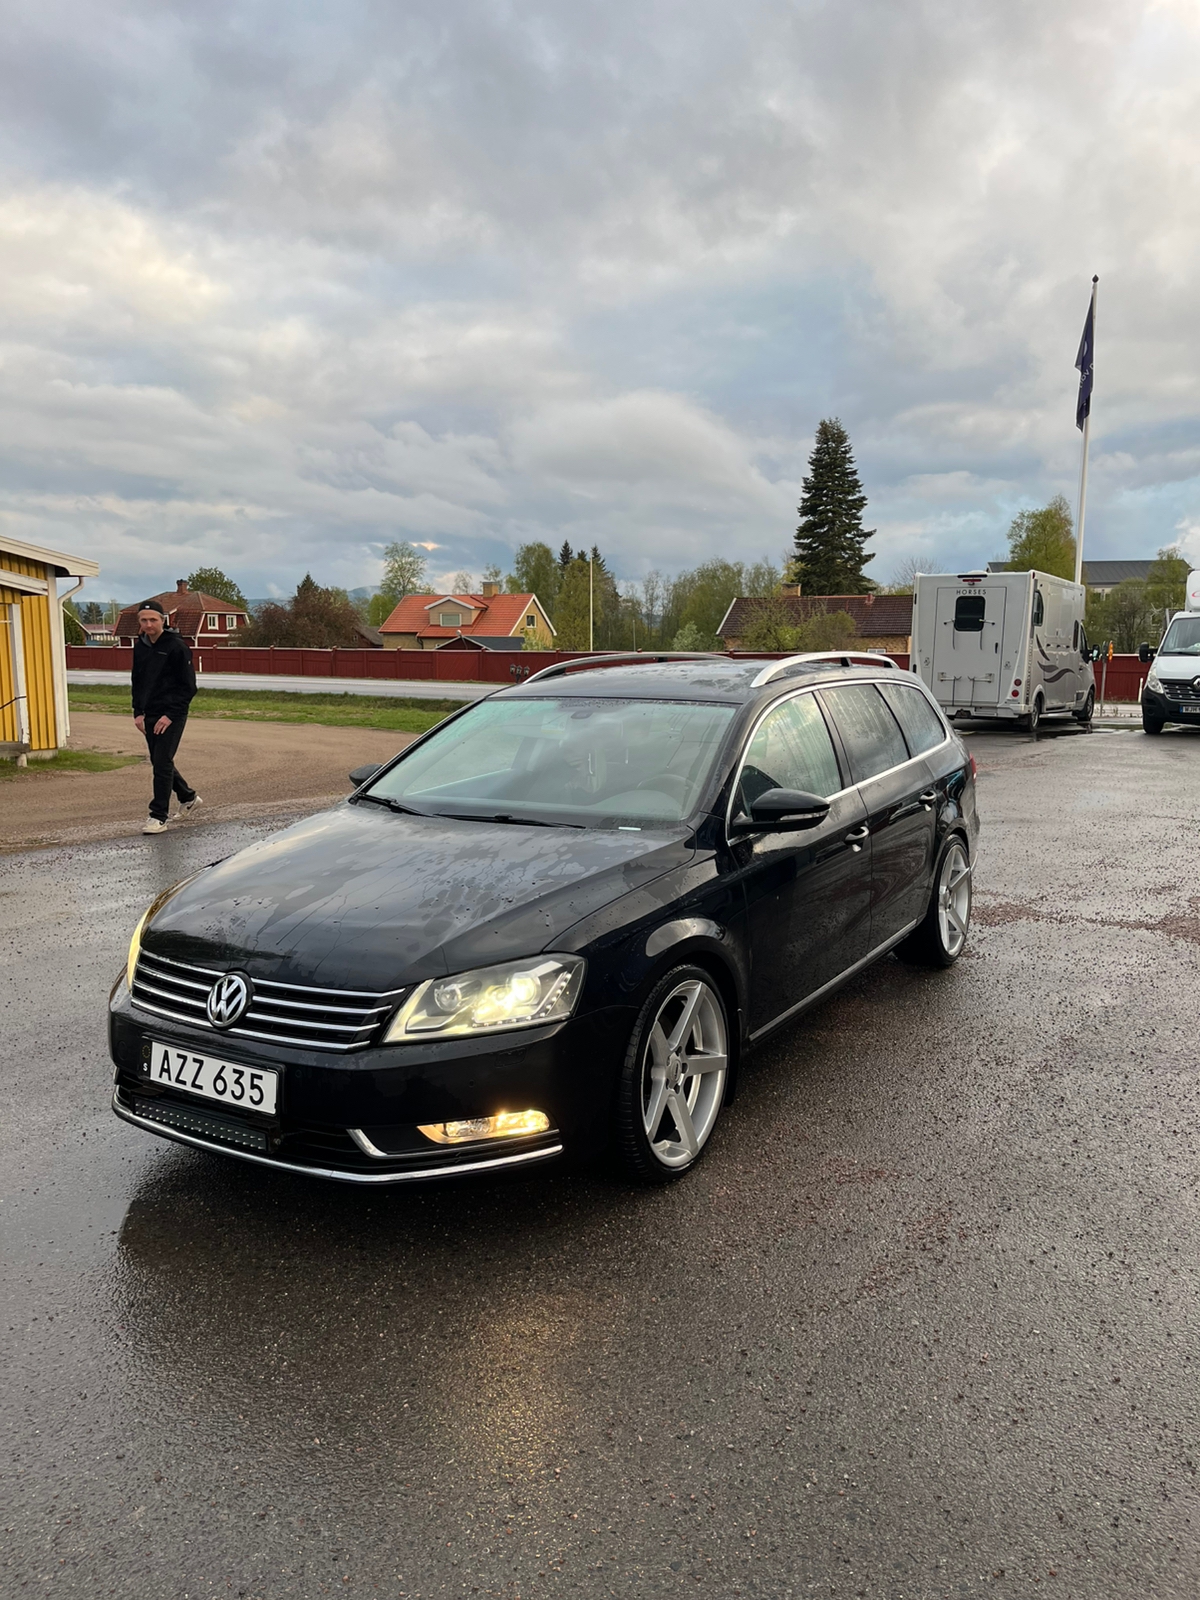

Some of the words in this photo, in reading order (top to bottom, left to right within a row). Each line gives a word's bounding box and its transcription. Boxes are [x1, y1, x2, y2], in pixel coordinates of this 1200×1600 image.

[207, 974, 247, 1027] VW
[142, 1062, 149, 1072] S
[158, 1049, 205, 1091] AZZ
[212, 1064, 265, 1106] 635
